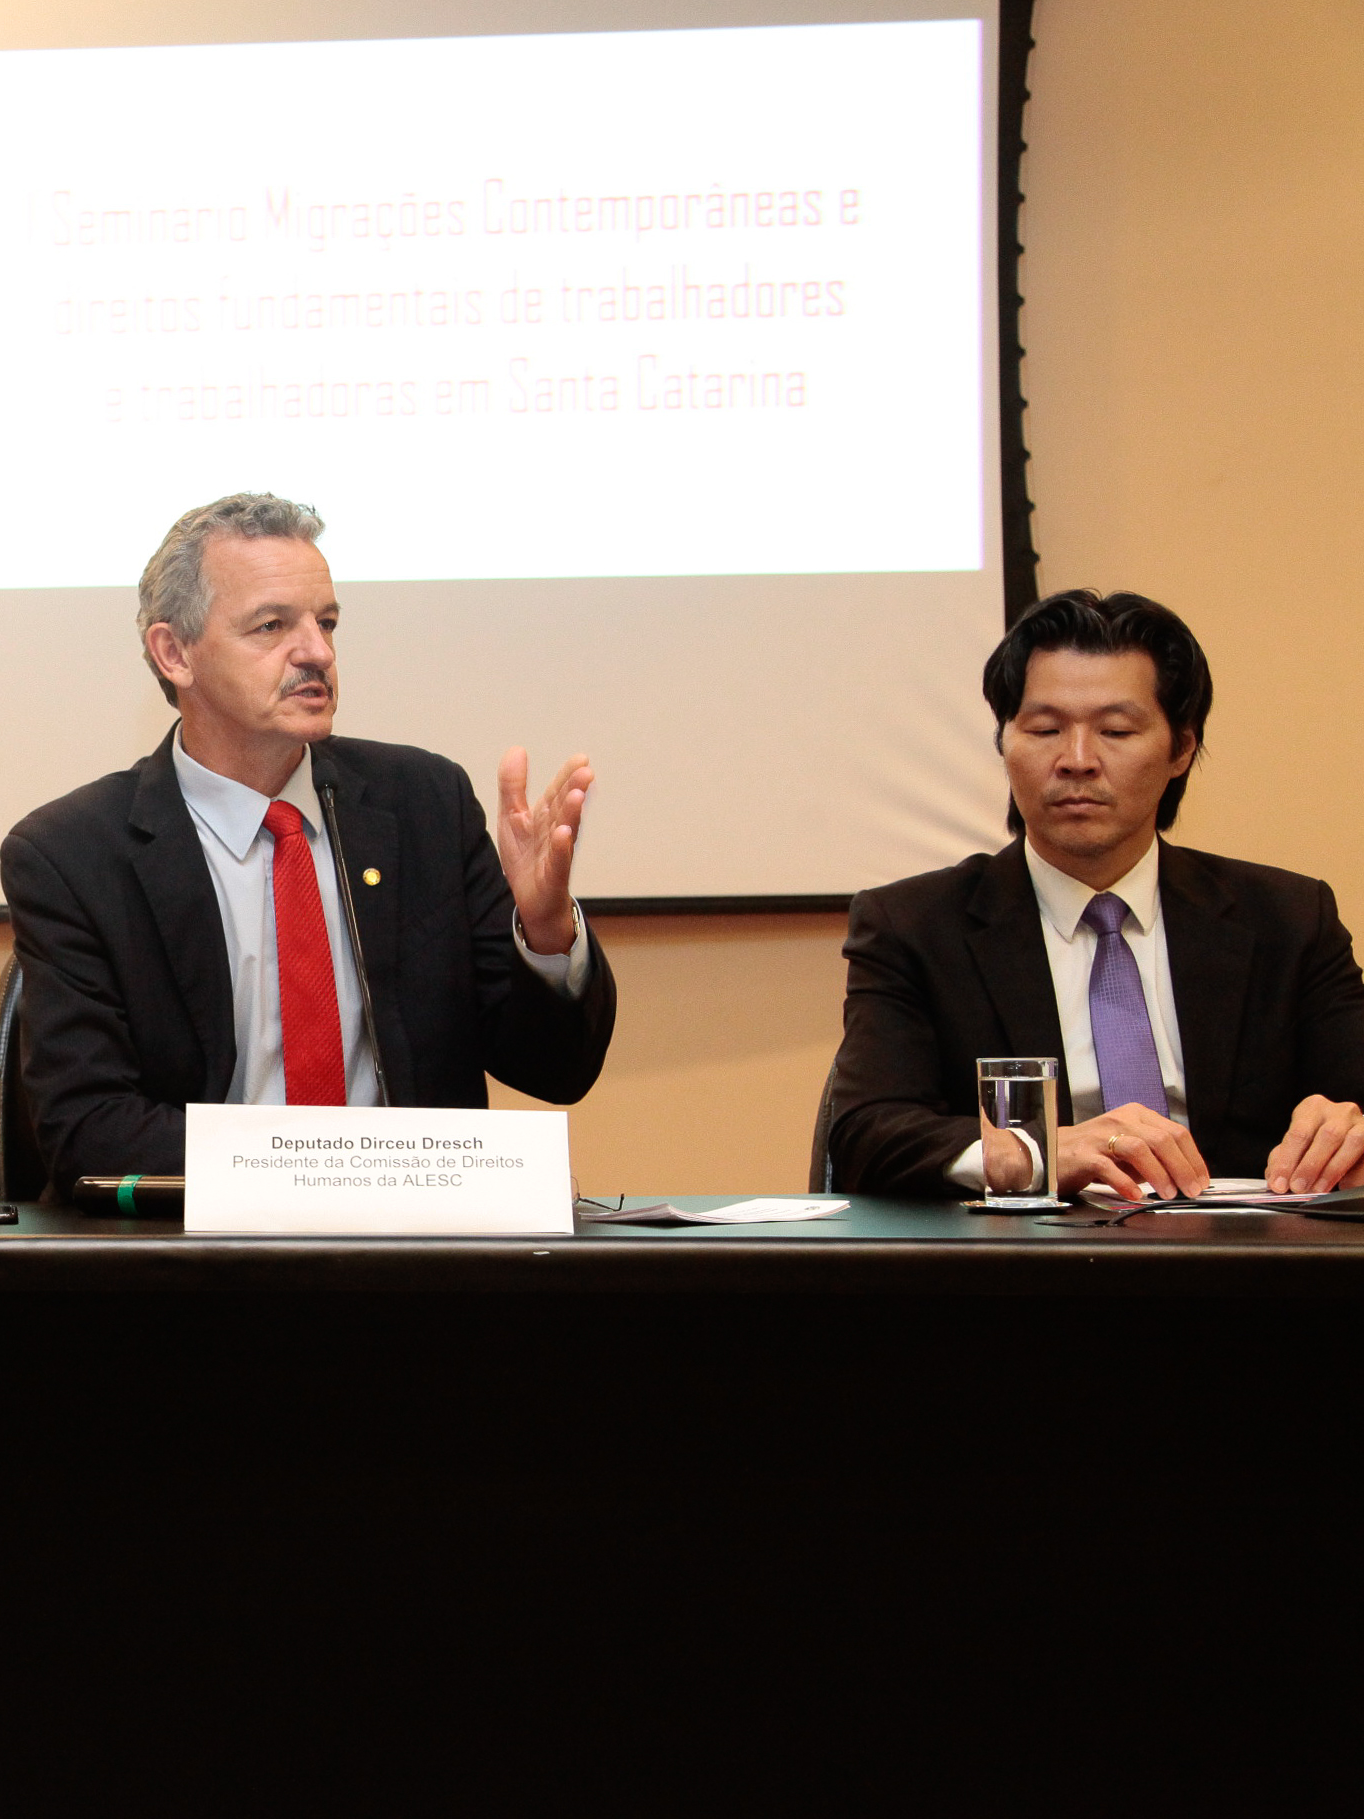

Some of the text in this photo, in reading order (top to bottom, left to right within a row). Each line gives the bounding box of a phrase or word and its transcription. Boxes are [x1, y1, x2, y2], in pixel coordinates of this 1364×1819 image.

[262, 184, 468, 254] Migrações
[483, 177, 824, 244] Contemporâneas
[839, 187, 864, 226] e
[55, 261, 848, 335] direitos fundamentais de trabalhadores
[140, 363, 417, 422] trabalhadoras
[435, 379, 493, 415] em
[508, 356, 621, 413] Santa
[637, 353, 808, 409] Catarina
[232, 1155, 525, 1169] Presidente da Comissão de Direitos
[271, 1136, 484, 1152] Deputado Dirceu Dresch
[293, 1173, 464, 1188] Humanos da ALESC
